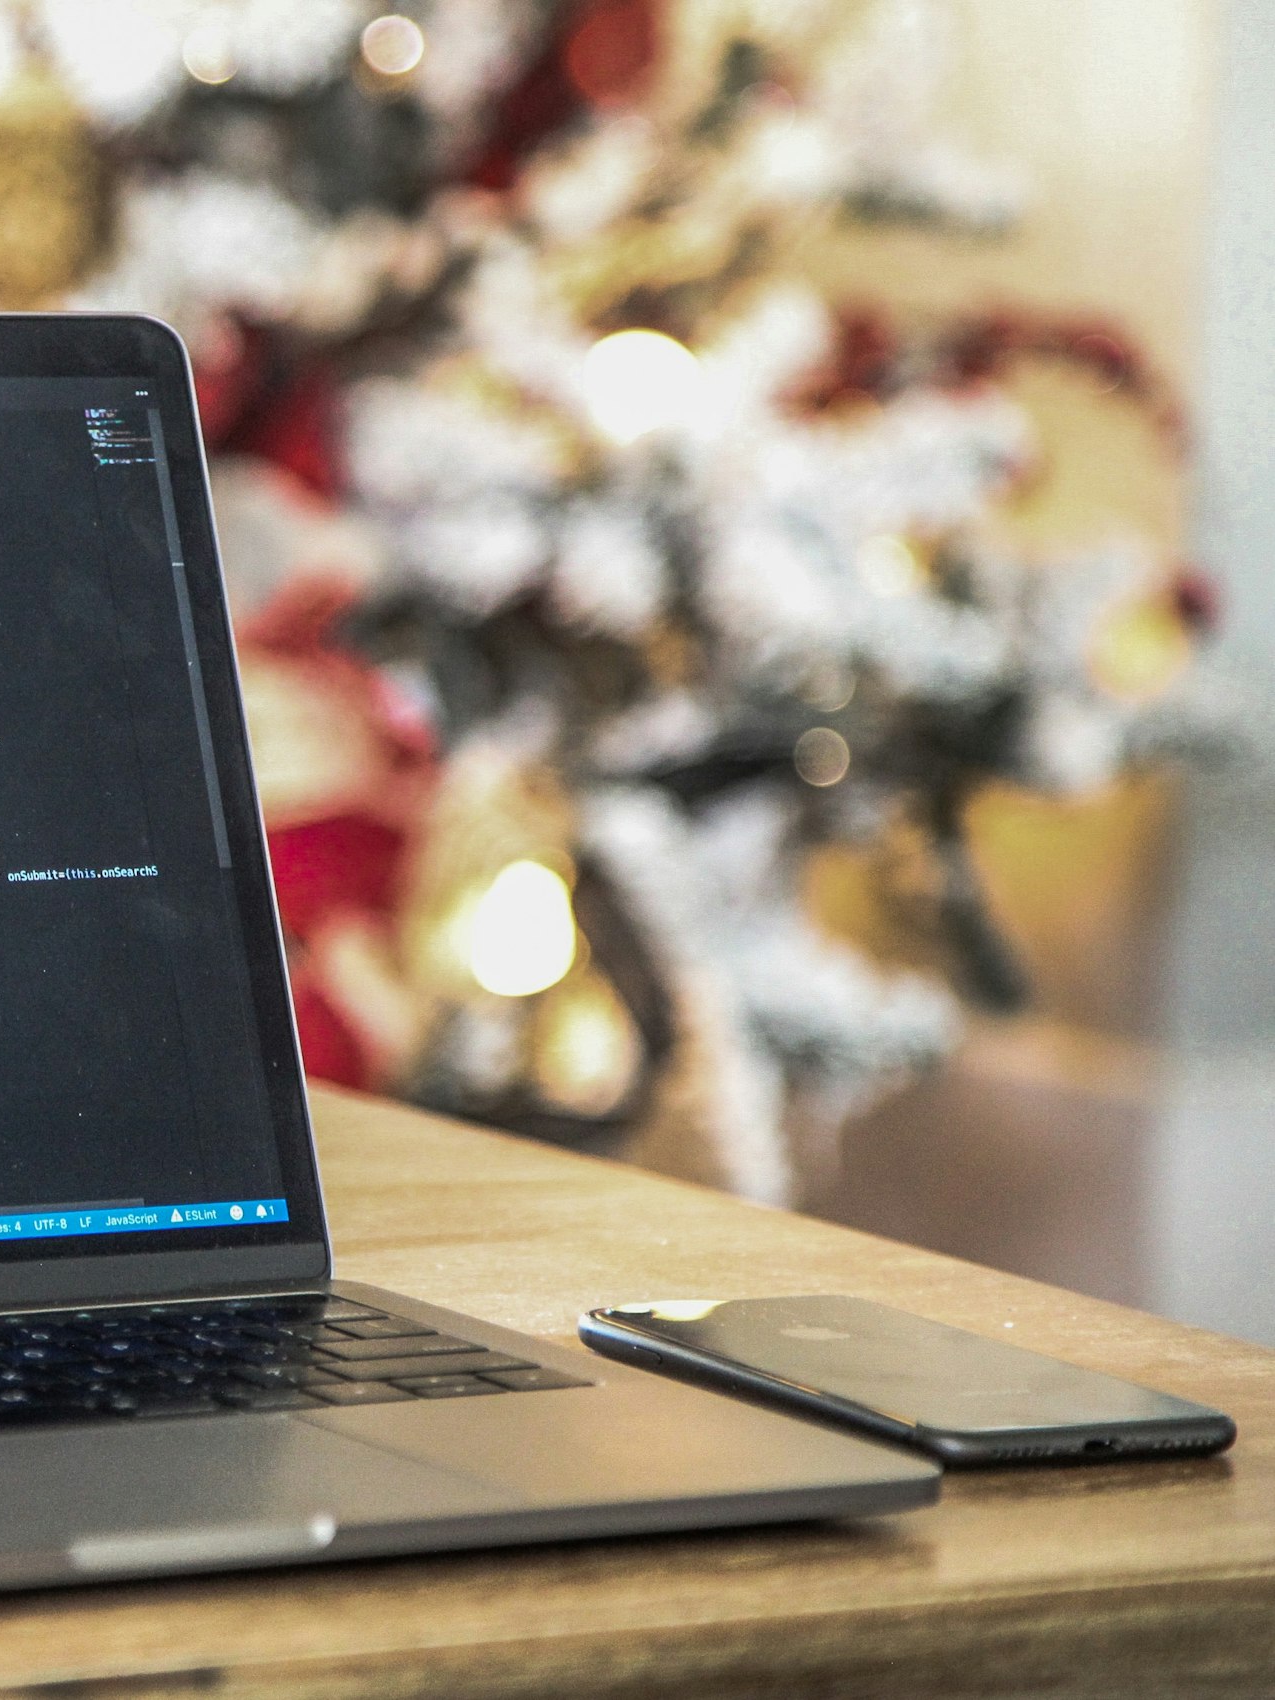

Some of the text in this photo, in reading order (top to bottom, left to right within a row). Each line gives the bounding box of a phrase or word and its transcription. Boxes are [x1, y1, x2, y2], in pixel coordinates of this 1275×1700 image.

[105, 1213, 158, 1227] JavaScript
[184, 1209, 217, 1221] ESLint
[33, 1217, 68, 1231] UTF-8
[79, 1216, 92, 1228] LF
